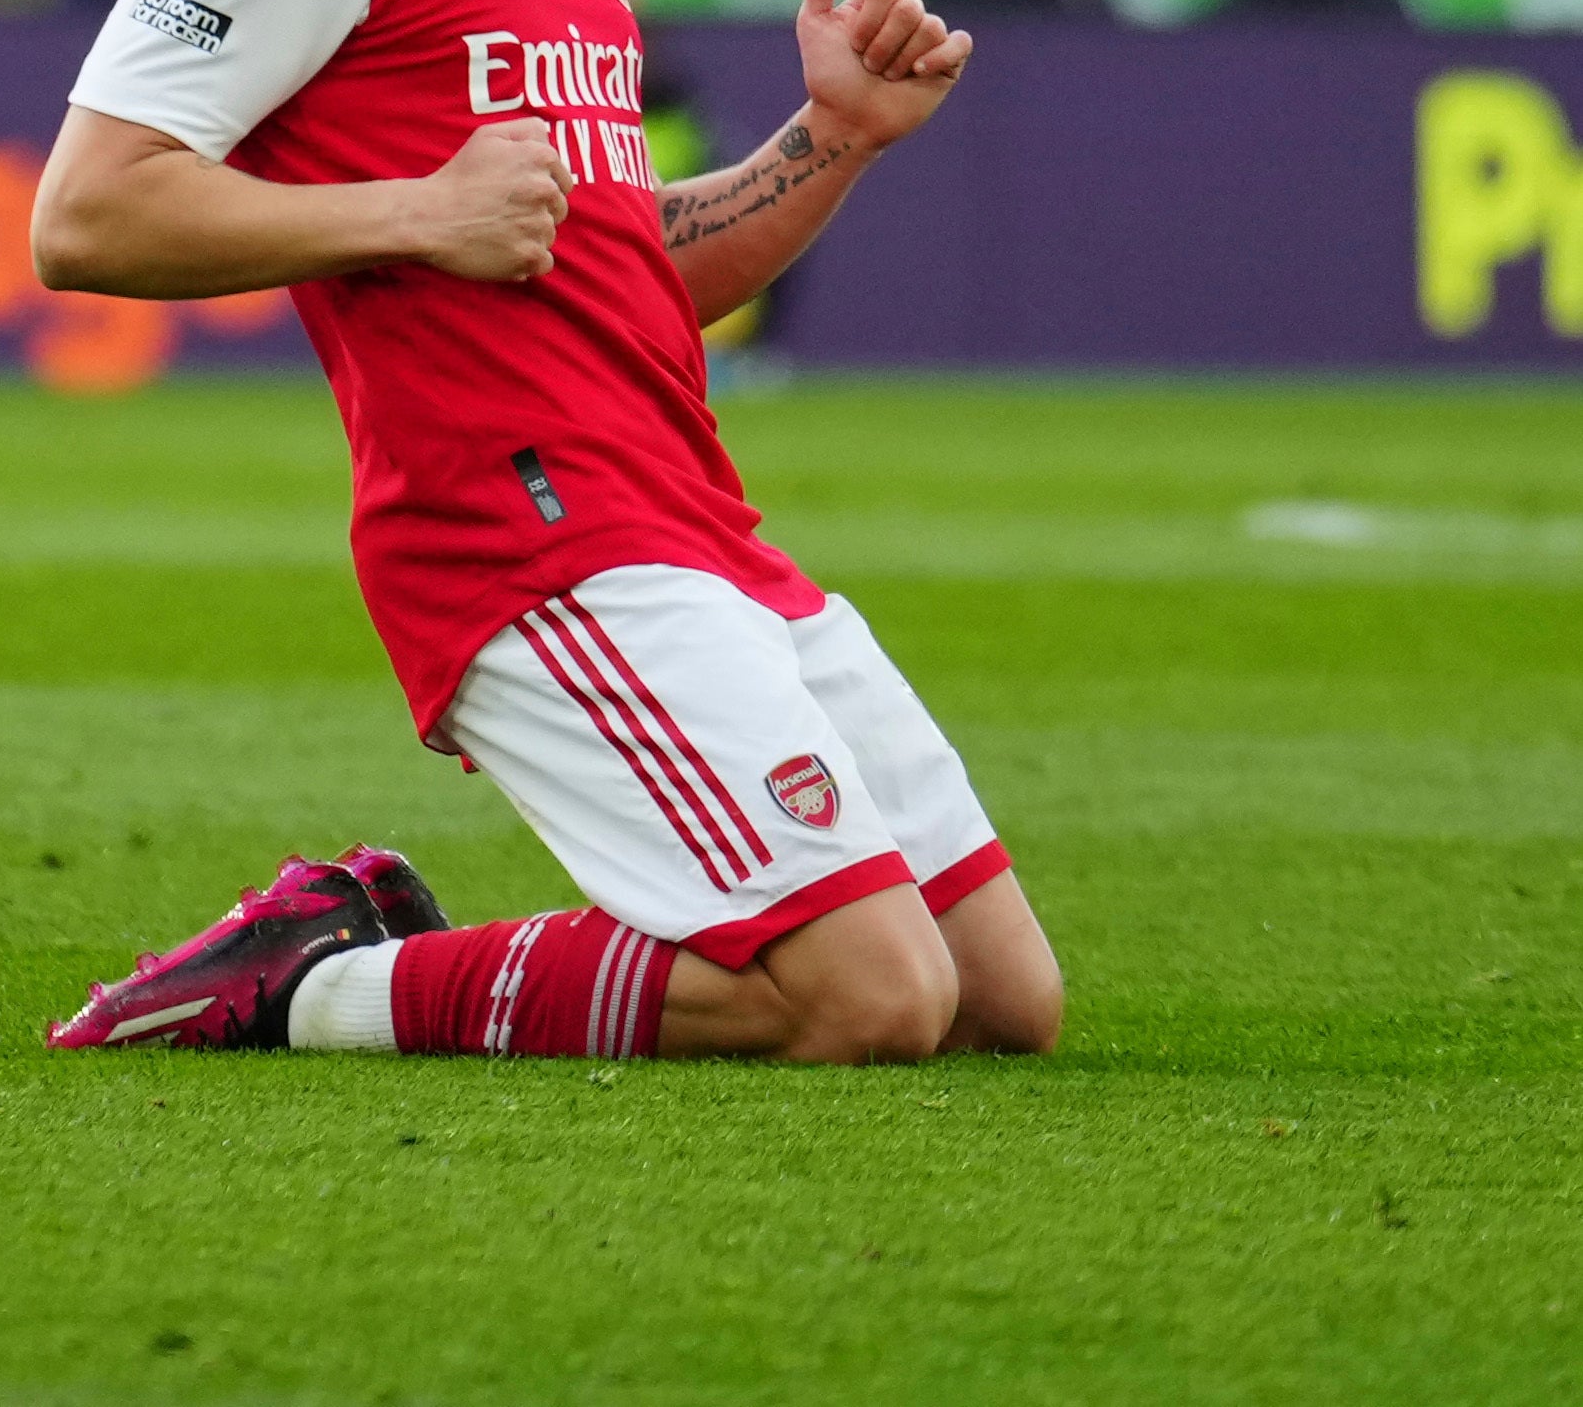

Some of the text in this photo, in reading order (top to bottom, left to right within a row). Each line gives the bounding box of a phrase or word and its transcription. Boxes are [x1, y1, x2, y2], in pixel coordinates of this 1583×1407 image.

[152, 9, 222, 55] racism
[461, 23, 644, 114] Emirat
[545, 118, 595, 186] LY
[773, 761, 822, 794] Arsenal
